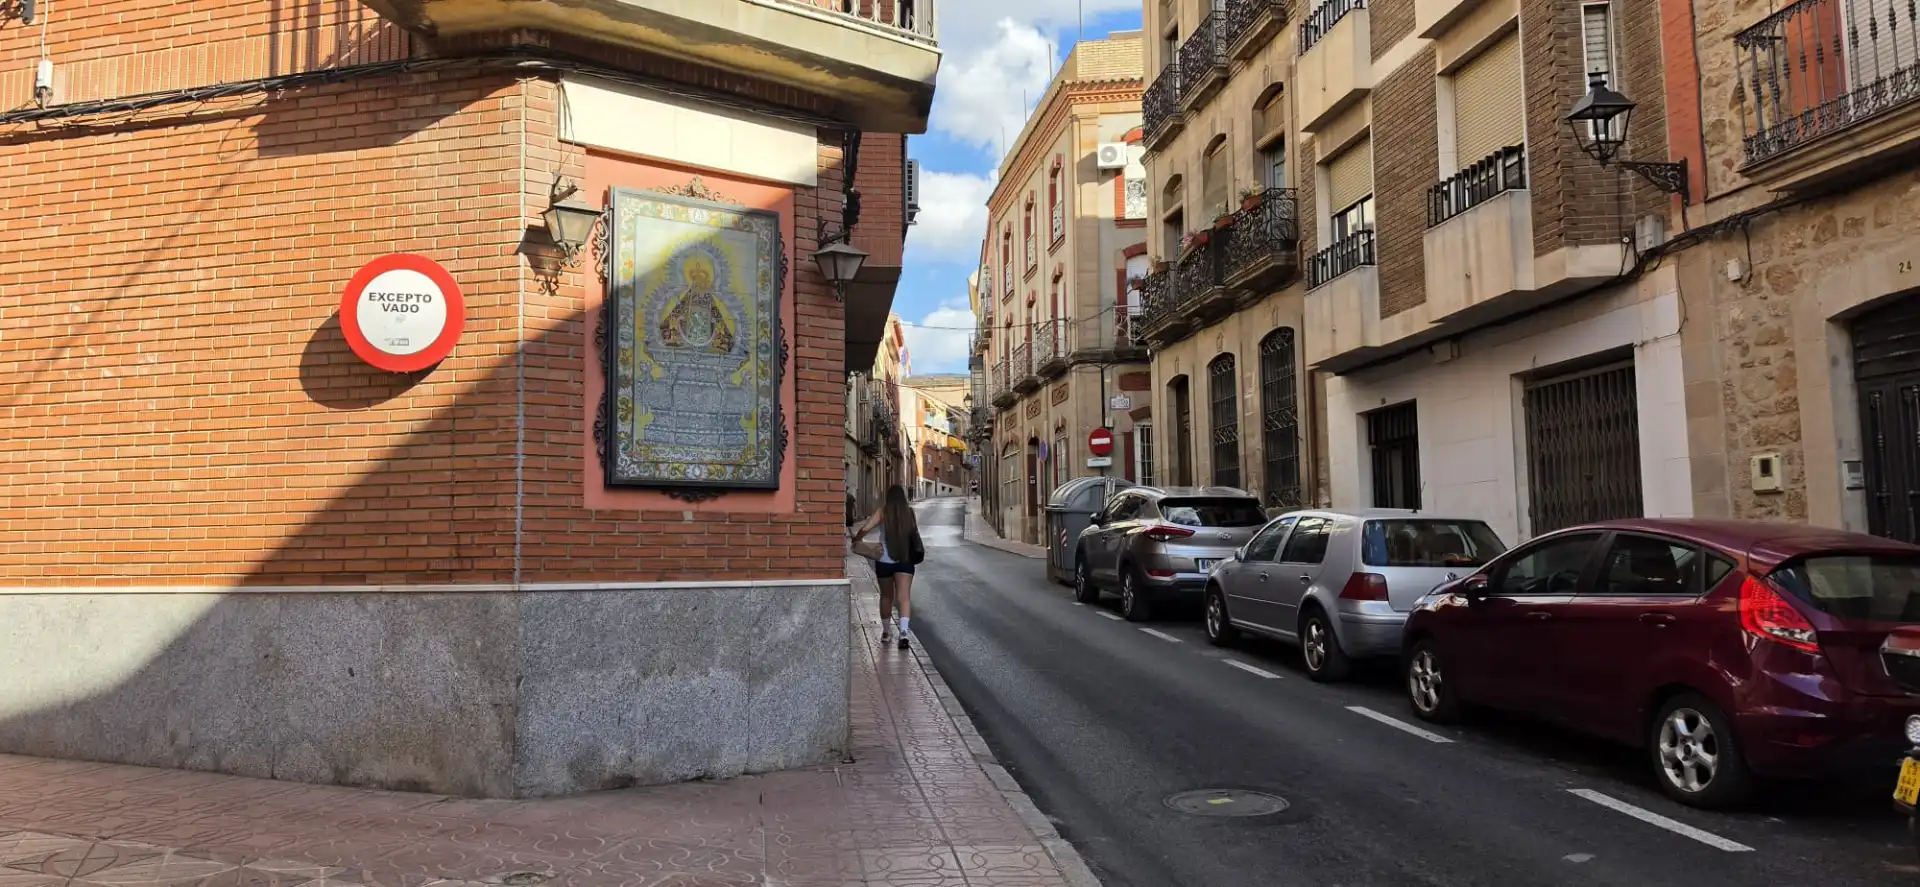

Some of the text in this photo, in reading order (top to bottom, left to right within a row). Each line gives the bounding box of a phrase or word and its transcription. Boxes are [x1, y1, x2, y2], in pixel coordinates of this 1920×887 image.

[1898, 260, 1912, 274] 24
[368, 292, 432, 304] EXCEPTO
[381, 302, 420, 314] VADO
